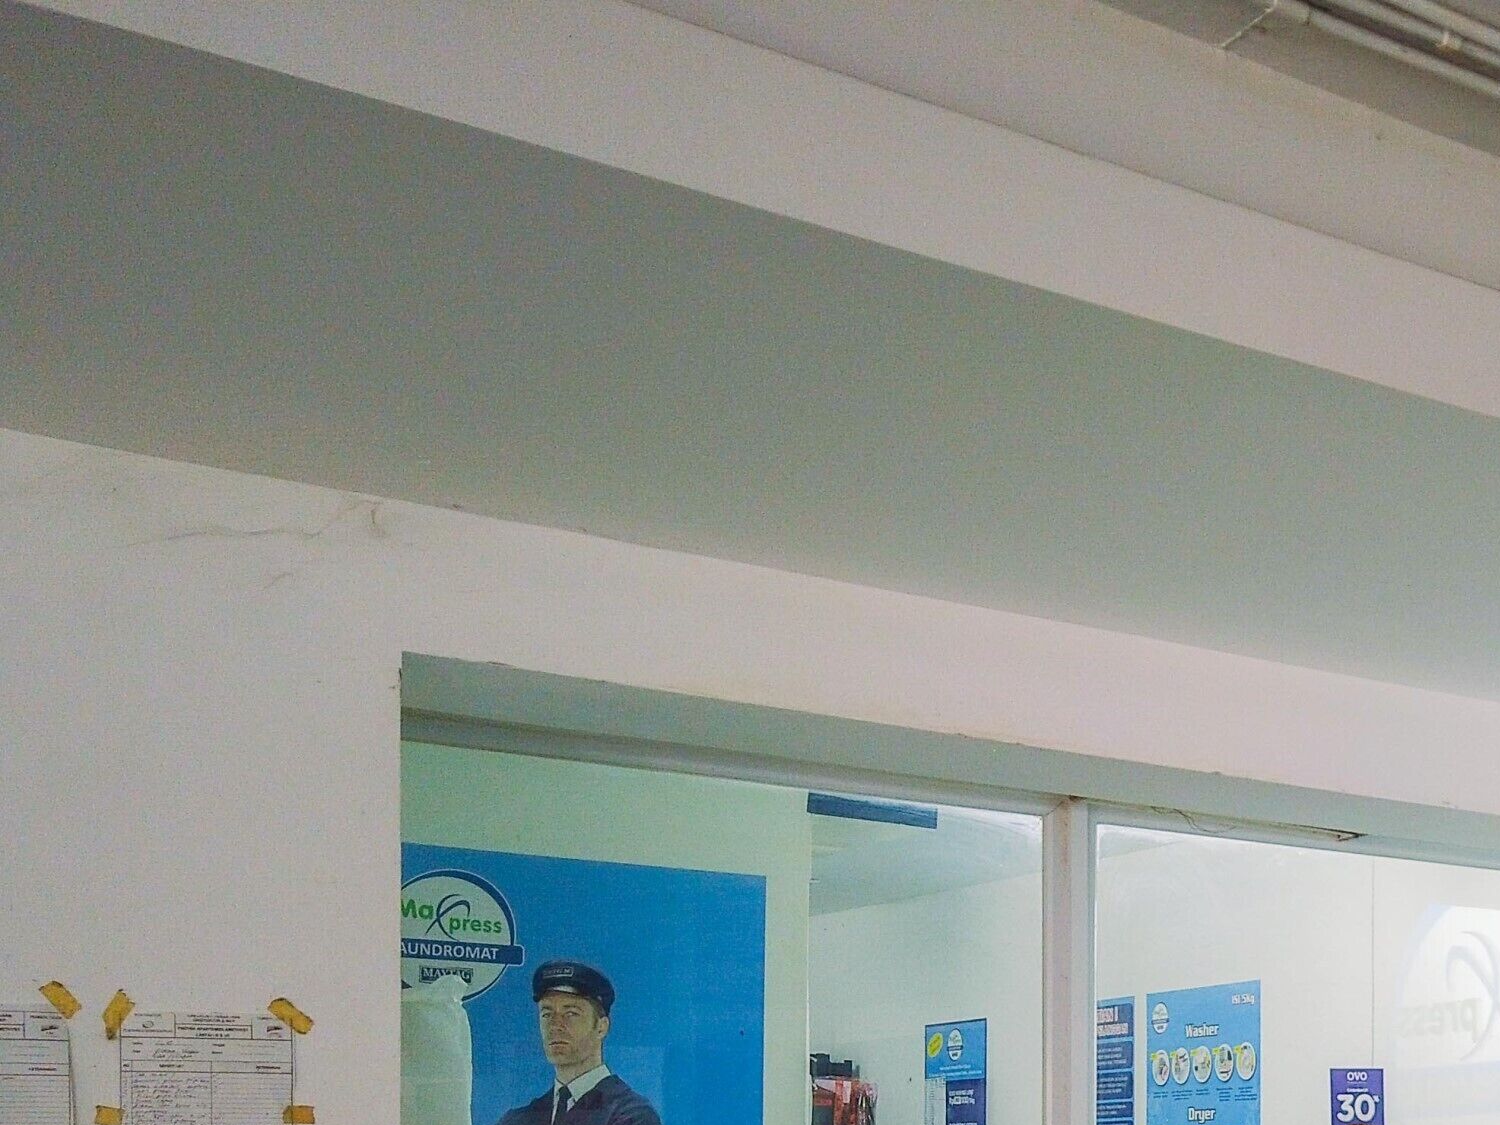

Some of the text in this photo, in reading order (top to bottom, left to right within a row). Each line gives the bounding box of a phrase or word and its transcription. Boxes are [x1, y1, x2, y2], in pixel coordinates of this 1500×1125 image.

[1185, 1023, 1219, 1038] Washer
[1346, 1071, 1368, 1081] OVO
[1187, 1107, 1216, 1124] Dryer
